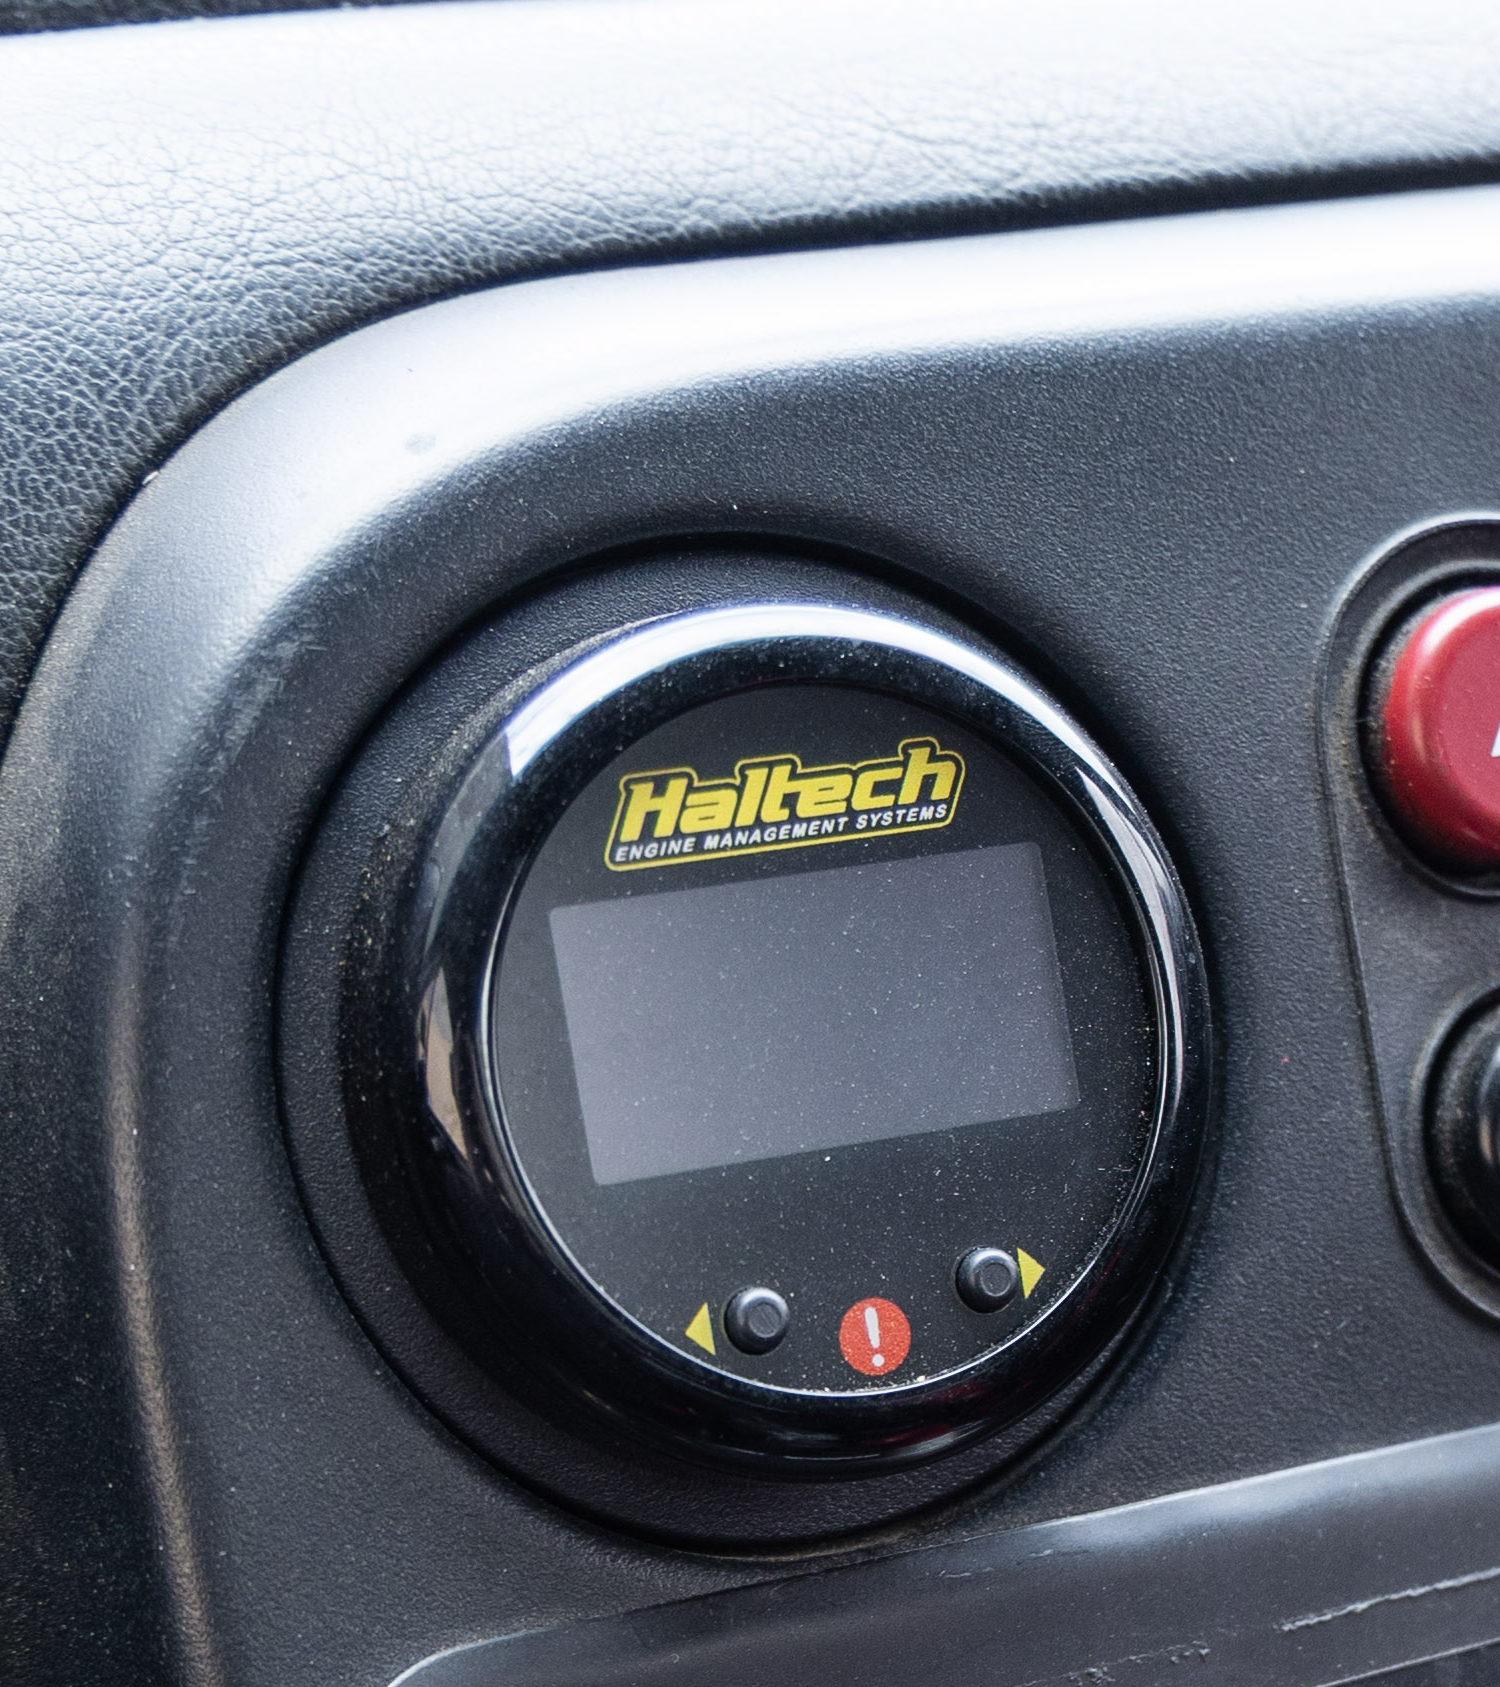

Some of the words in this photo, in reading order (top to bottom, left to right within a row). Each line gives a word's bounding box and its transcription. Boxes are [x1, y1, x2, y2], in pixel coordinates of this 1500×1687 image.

[614, 836, 696, 864] ENGINE
[703, 816, 849, 852] MANAGEMENT
[855, 803, 949, 831] SYSTEMS
[618, 745, 959, 843] Haltech
